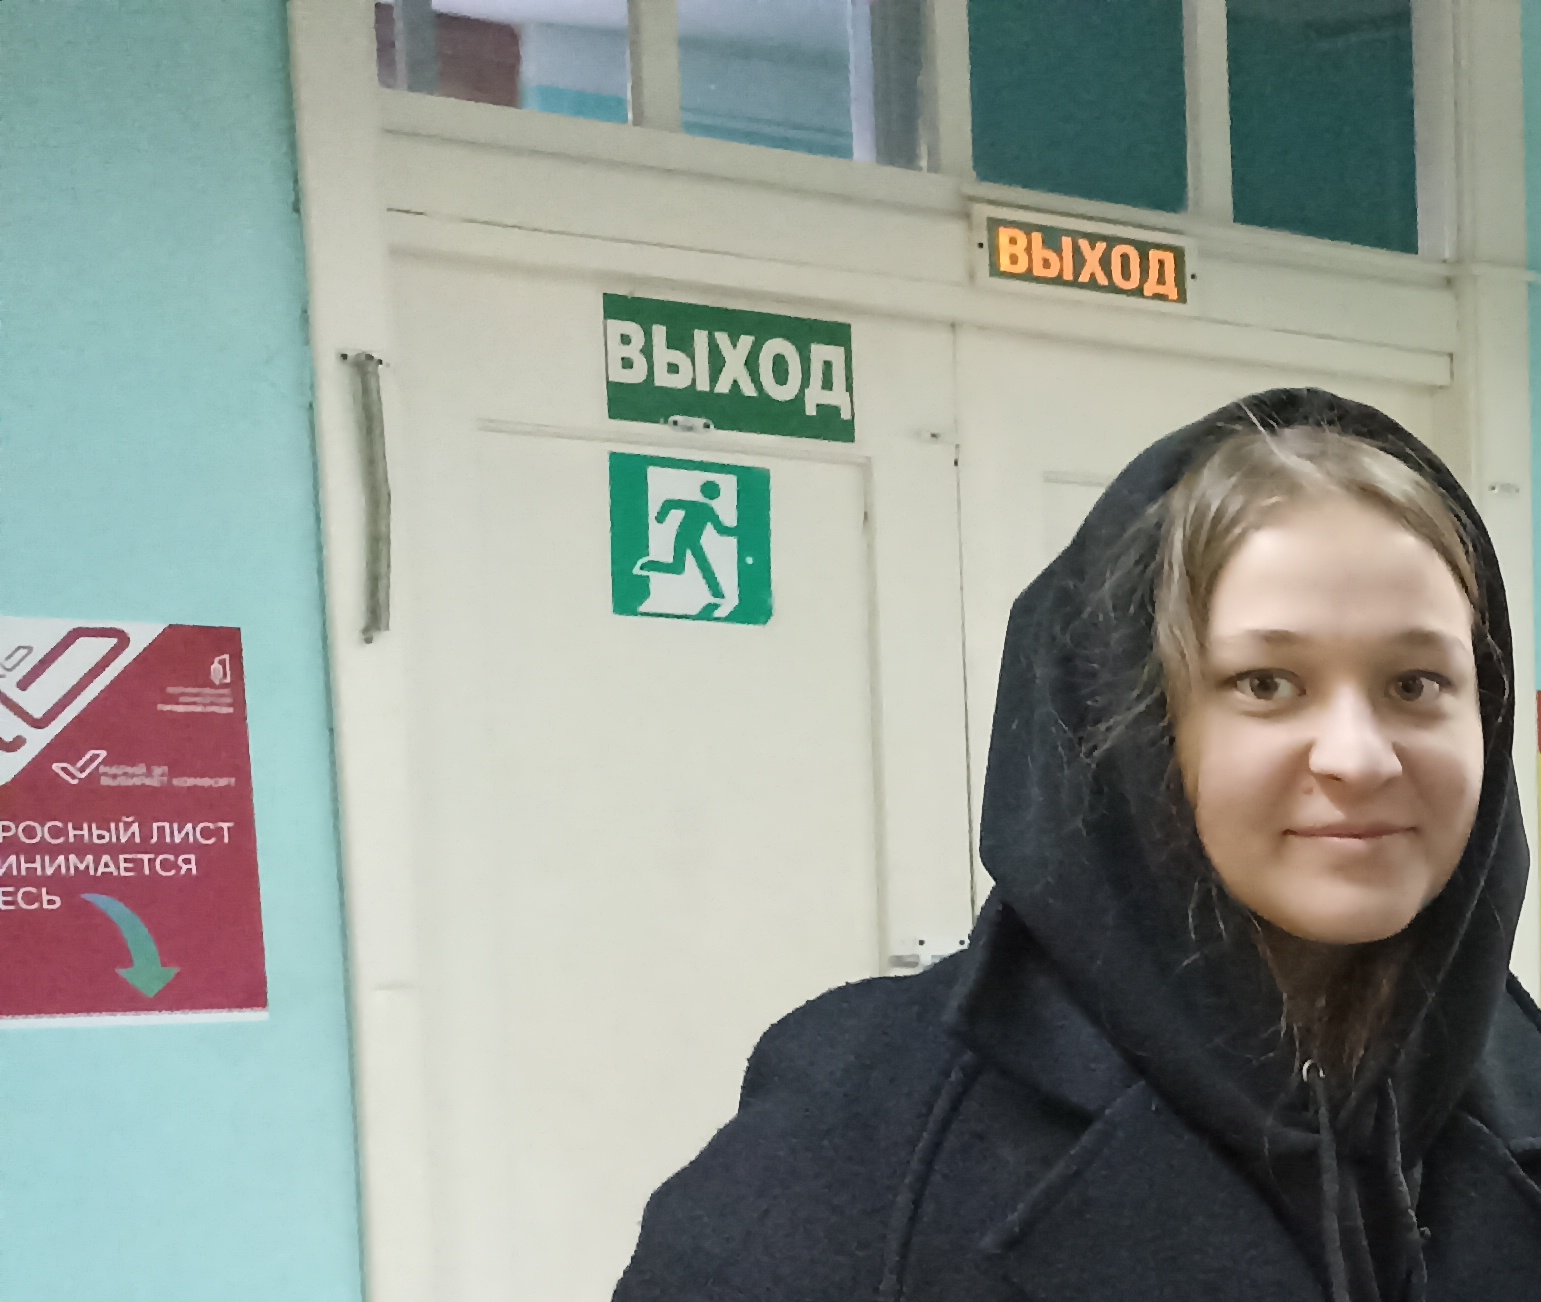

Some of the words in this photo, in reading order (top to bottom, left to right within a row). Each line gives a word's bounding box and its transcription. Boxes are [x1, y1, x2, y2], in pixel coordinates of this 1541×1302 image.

[998, 226, 1178, 300] ВЫХОД
[606, 318, 852, 420] ВЫХОД
[0, 816, 141, 844] РОСНЫЙ
[150, 822, 235, 844] ЛИСТ
[0, 887, 62, 910] ЕСЬ
